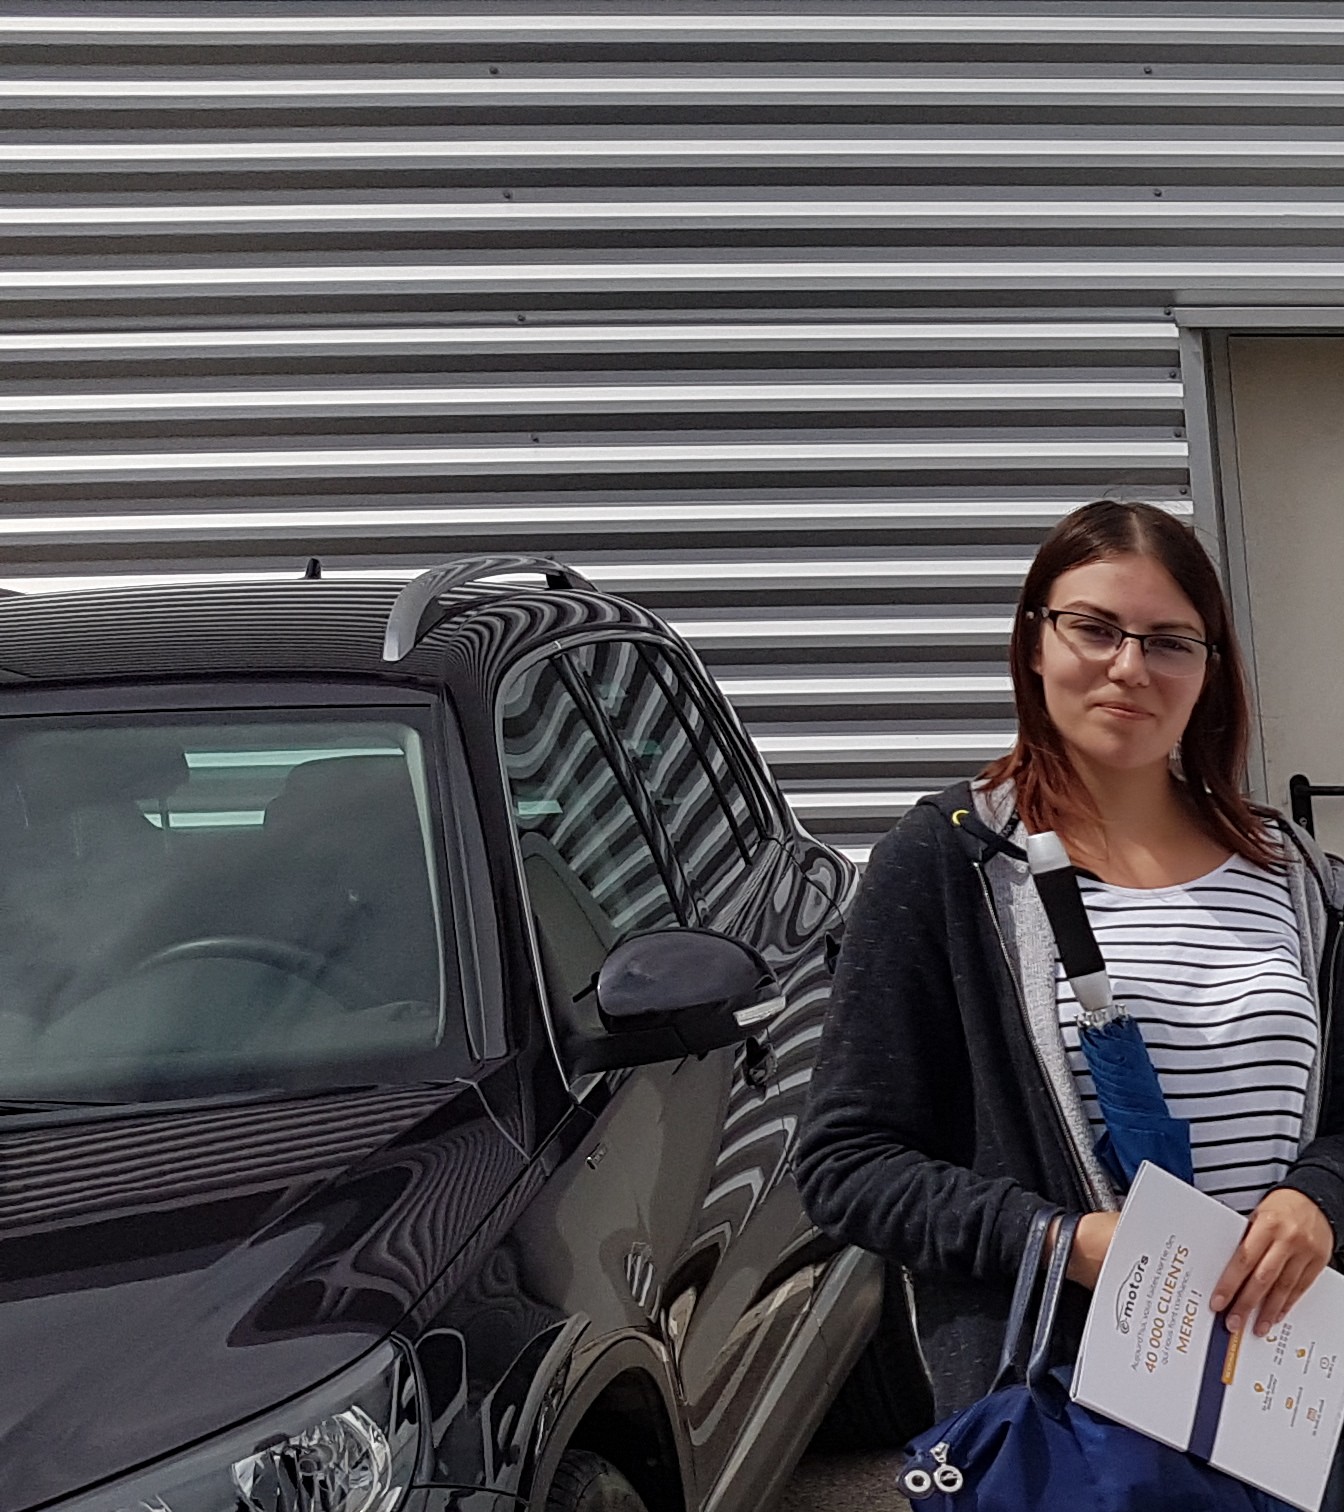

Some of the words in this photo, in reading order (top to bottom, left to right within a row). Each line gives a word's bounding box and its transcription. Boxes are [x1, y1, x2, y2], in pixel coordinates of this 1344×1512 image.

[1158, 1245, 1188, 1314] CLIENTS
[1149, 1317, 1165, 1349] 000
[1176, 1299, 1199, 1354] MERCI
[1145, 1351, 1158, 1373] 40
